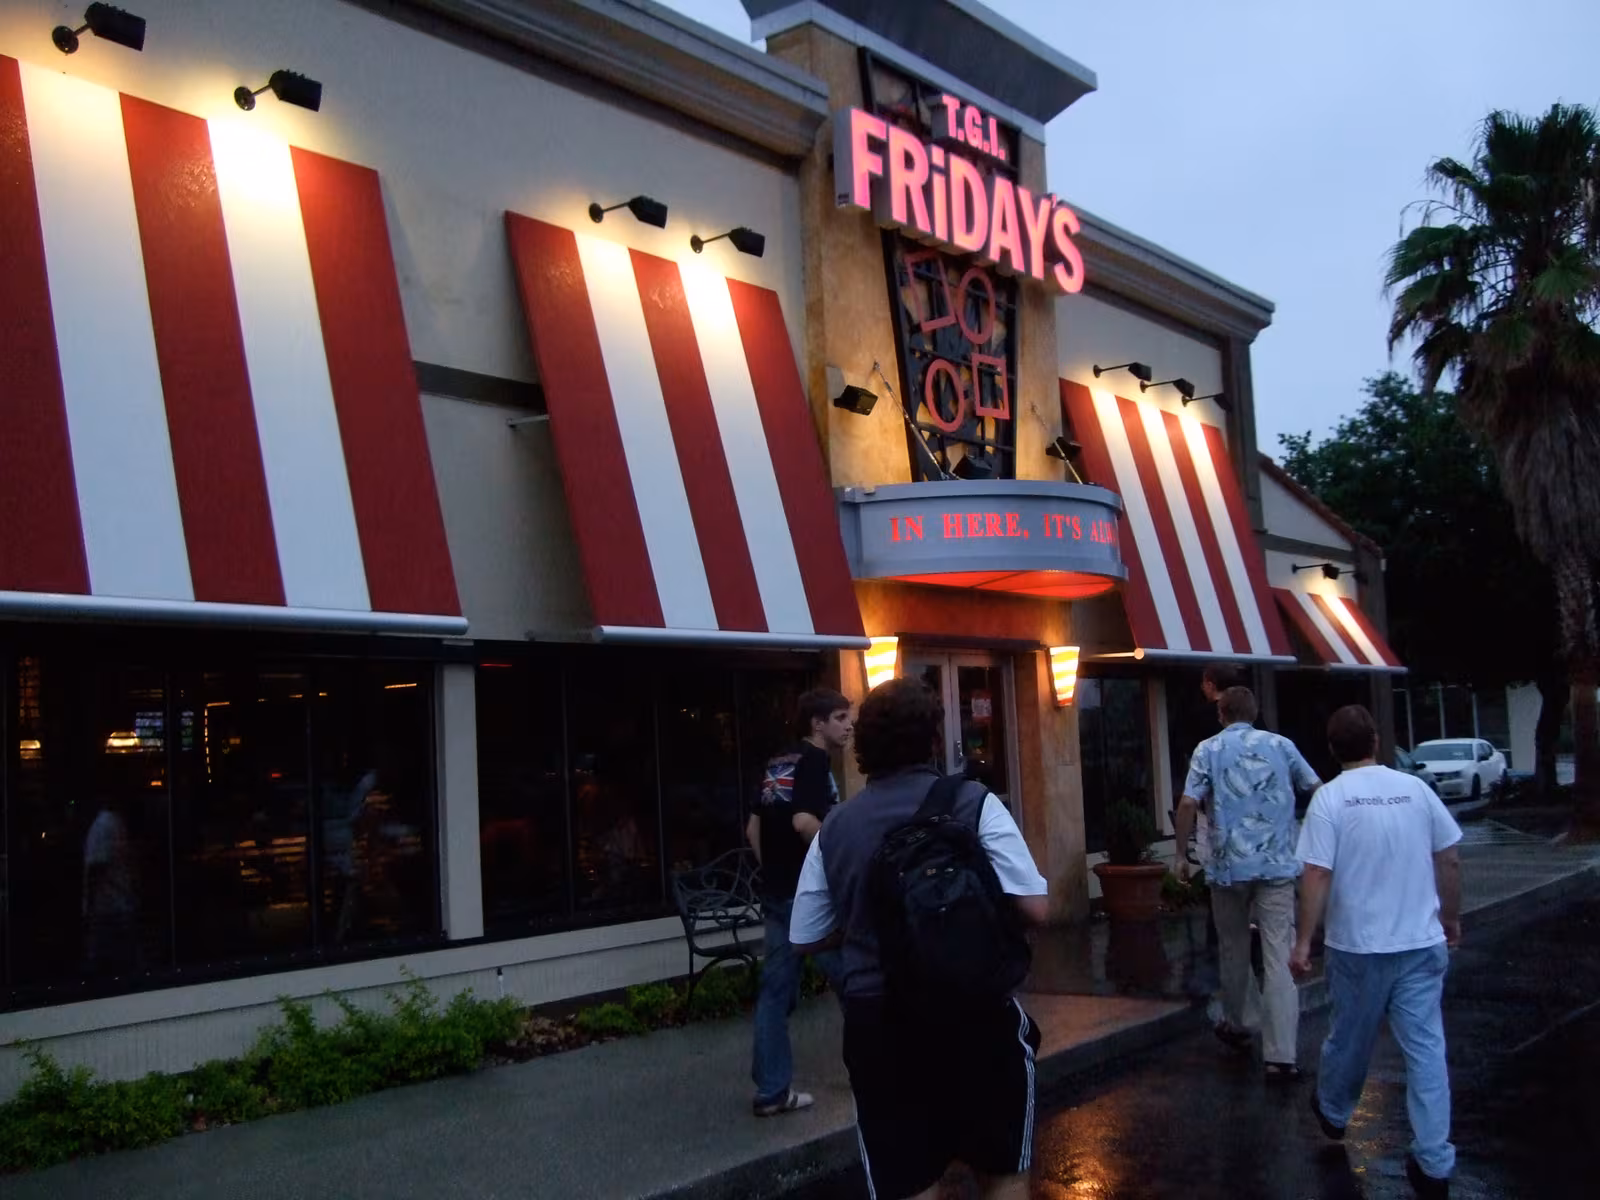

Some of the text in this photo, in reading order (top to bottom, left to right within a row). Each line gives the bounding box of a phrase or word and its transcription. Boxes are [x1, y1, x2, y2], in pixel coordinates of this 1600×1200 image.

[943, 93, 1006, 161] T.G.I.
[890, 515, 924, 543] IN
[943, 512, 1029, 540] HERE,
[1043, 513, 1082, 540] IT'S
